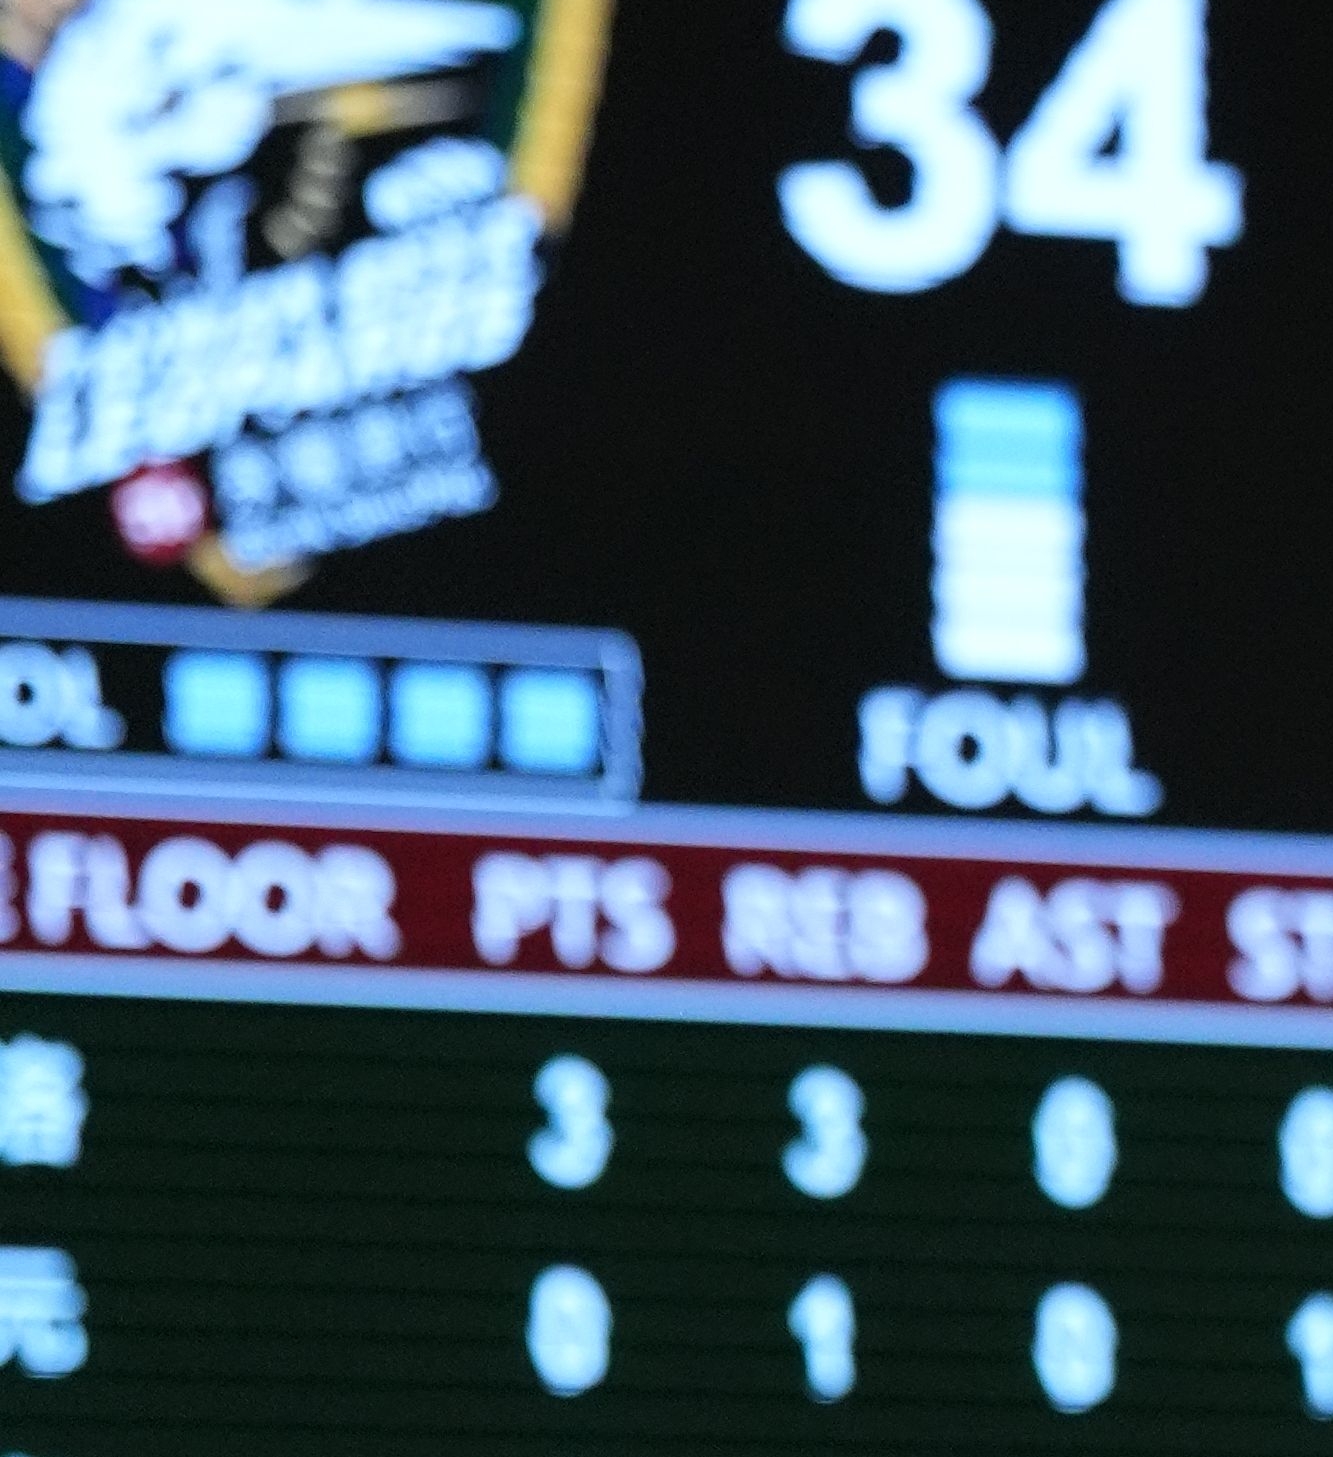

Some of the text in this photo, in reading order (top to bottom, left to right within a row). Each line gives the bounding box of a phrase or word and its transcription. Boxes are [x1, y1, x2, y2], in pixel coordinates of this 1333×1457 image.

[857, 684, 1165, 817] FOUL
[27, 829, 402, 962] FLOOR
[472, 851, 675, 972] PTS
[722, 863, 928, 984] REB
[971, 875, 1180, 994] AST
[526, 1054, 614, 1190] 3
[782, 1064, 868, 1200] 3
[788, 1272, 857, 1404] 1
